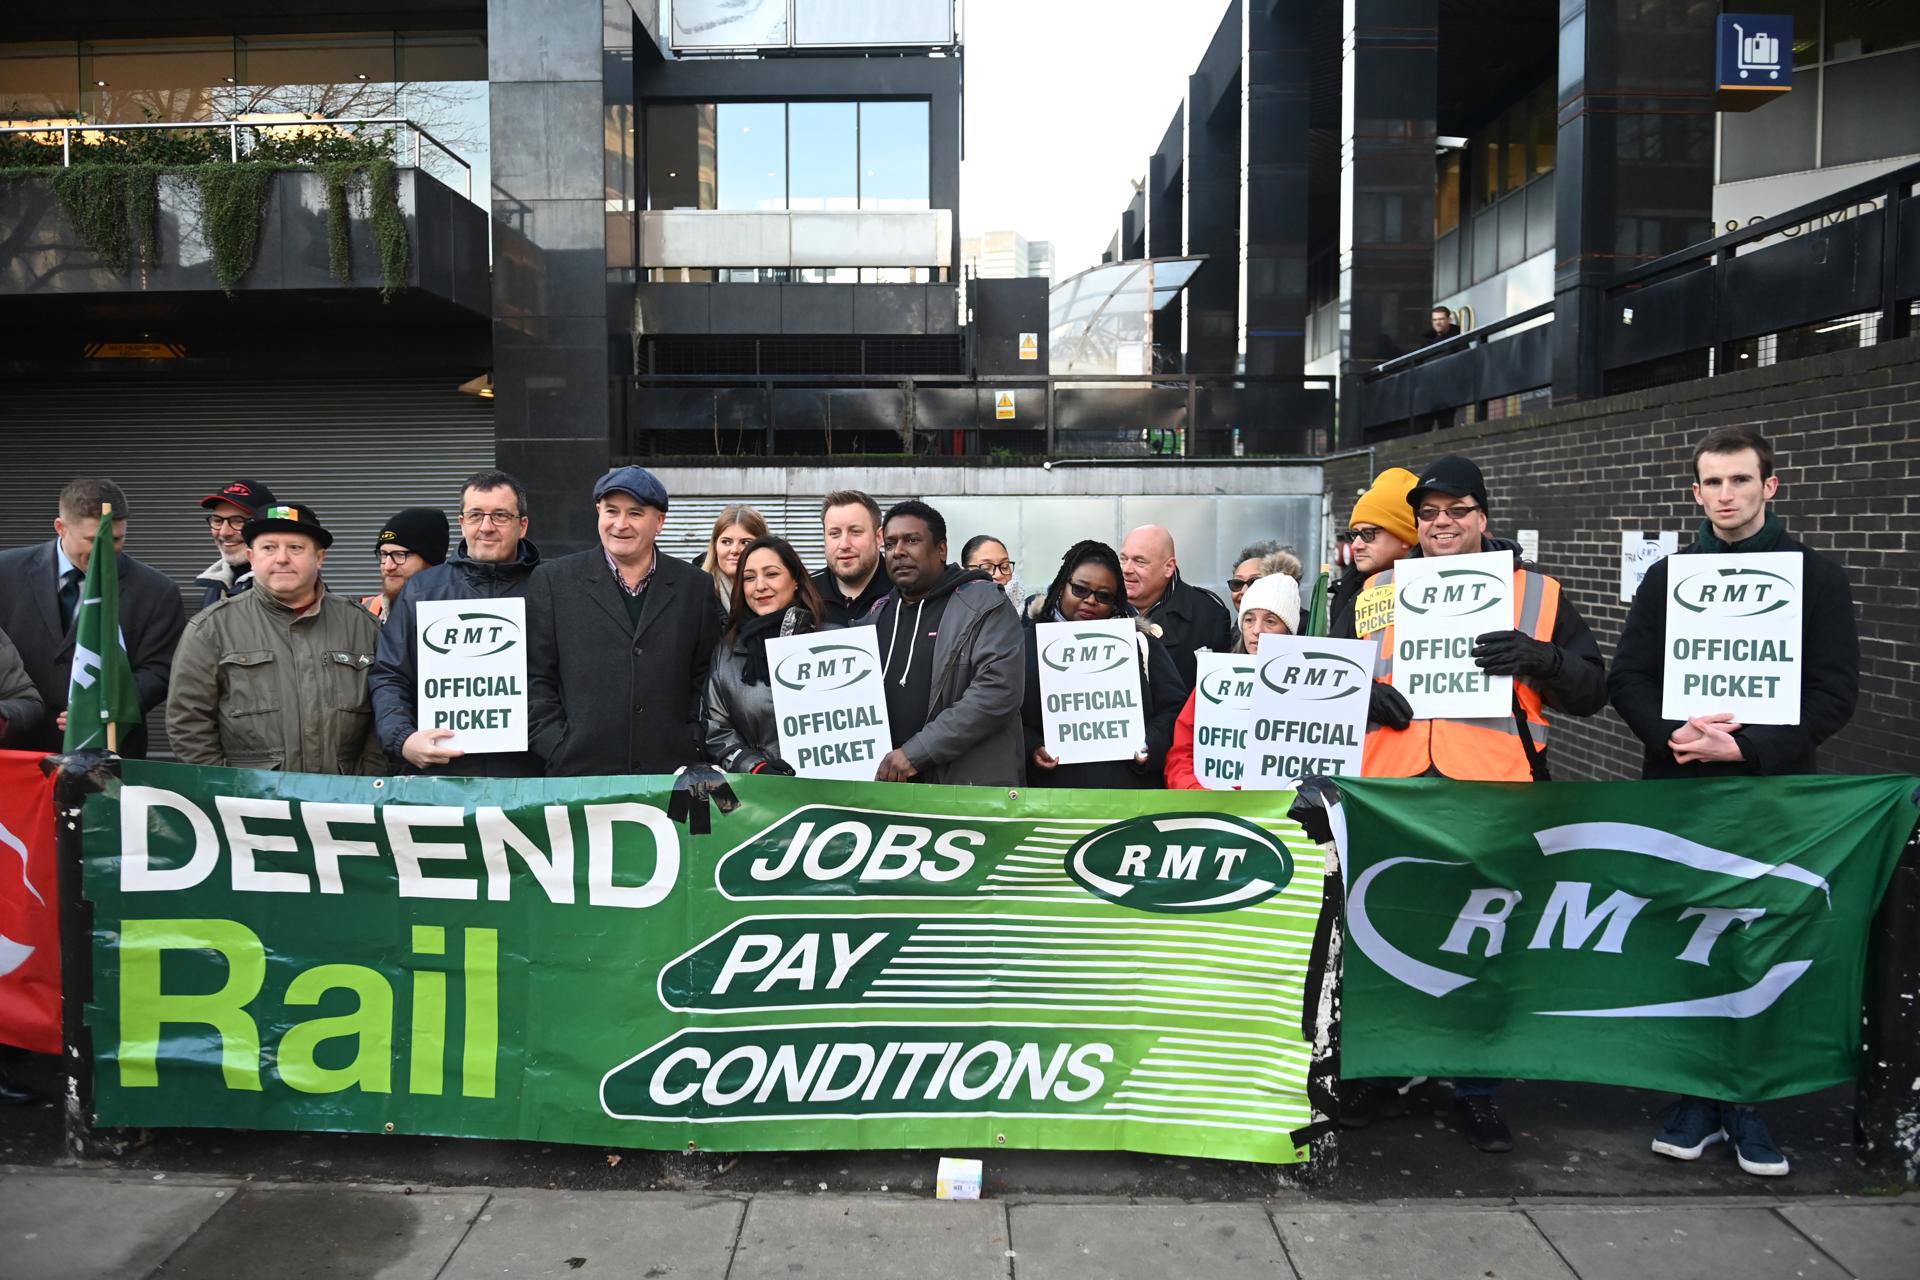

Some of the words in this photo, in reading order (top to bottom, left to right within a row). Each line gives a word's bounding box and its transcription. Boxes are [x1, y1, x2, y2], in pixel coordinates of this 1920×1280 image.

[1422, 583, 1487, 604] RMT
[1698, 584, 1773, 602] RMT
[1355, 599, 1394, 621] OFFICI
[1360, 611, 1394, 634] PICKE
[444, 627, 502, 645] RMT
[1062, 645, 1116, 663] RMT
[1400, 637, 1475, 661] OFFICI
[1673, 638, 1794, 662] OFFICIAL
[797, 656, 856, 681] RMT
[1282, 667, 1348, 687] RMT
[424, 676, 522, 699] OFFICIAL
[1218, 680, 1254, 697] RM
[1409, 672, 1490, 694] PICKET
[1683, 674, 1780, 698] PICKET
[1047, 689, 1138, 713] OFFICIAL
[435, 709, 512, 730] PICKET
[783, 705, 883, 737] OFFICIAL
[1058, 720, 1130, 742] PICKET
[1199, 726, 1248, 750] OFFIC
[1254, 718, 1358, 747] OFFICIAL
[798, 739, 876, 769] PICKET
[1204, 758, 1244, 780] PICK
[1261, 755, 1346, 778] PICKET
[120, 785, 681, 908] DEFEND
[750, 821, 986, 882] JOBS
[1116, 845, 1247, 882] RMT
[1438, 881, 1766, 967] RMT
[711, 932, 890, 995] PAY
[119, 919, 498, 1099] Rail
[649, 1040, 1115, 1107] CONDITIONS
